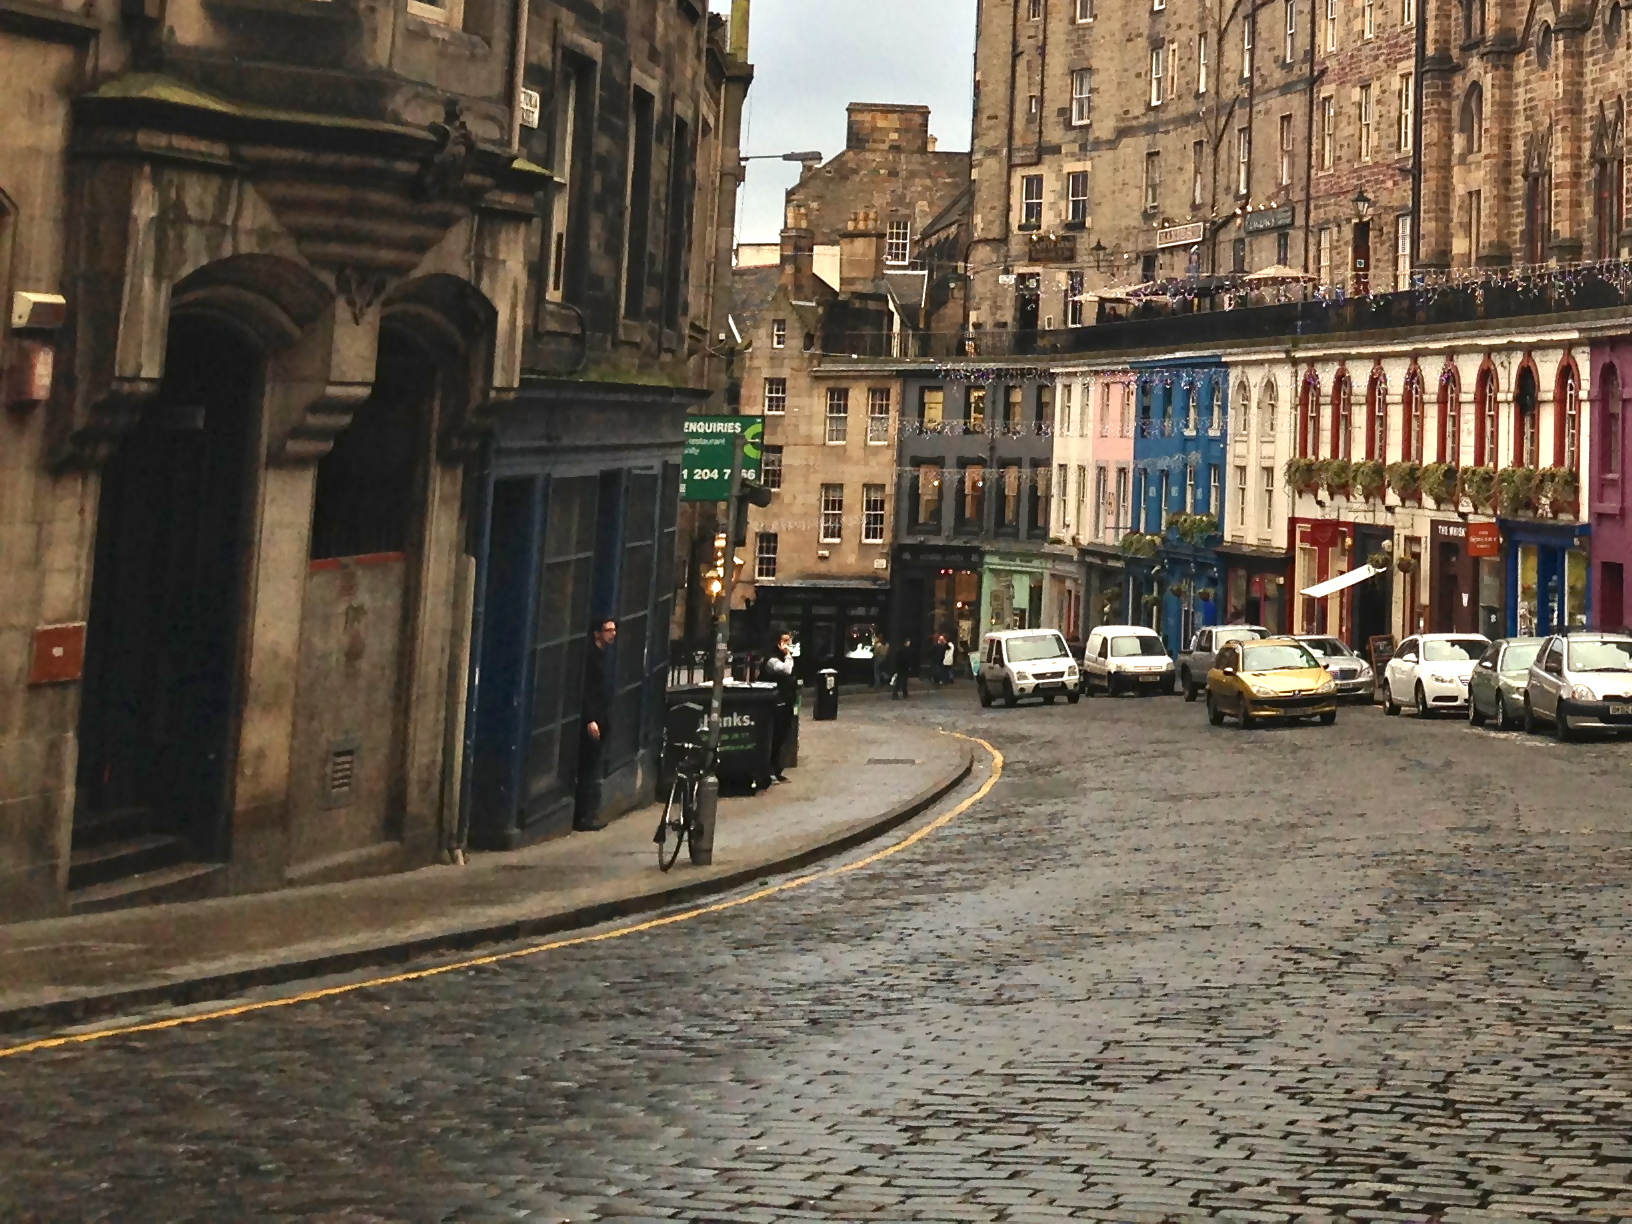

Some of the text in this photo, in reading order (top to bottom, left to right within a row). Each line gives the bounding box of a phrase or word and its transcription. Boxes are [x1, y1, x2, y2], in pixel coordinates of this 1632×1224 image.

[683, 421, 742, 433] ENQUIRIES
[692, 468, 719, 480] 204
[1438, 525, 1467, 537] THE WHISK
